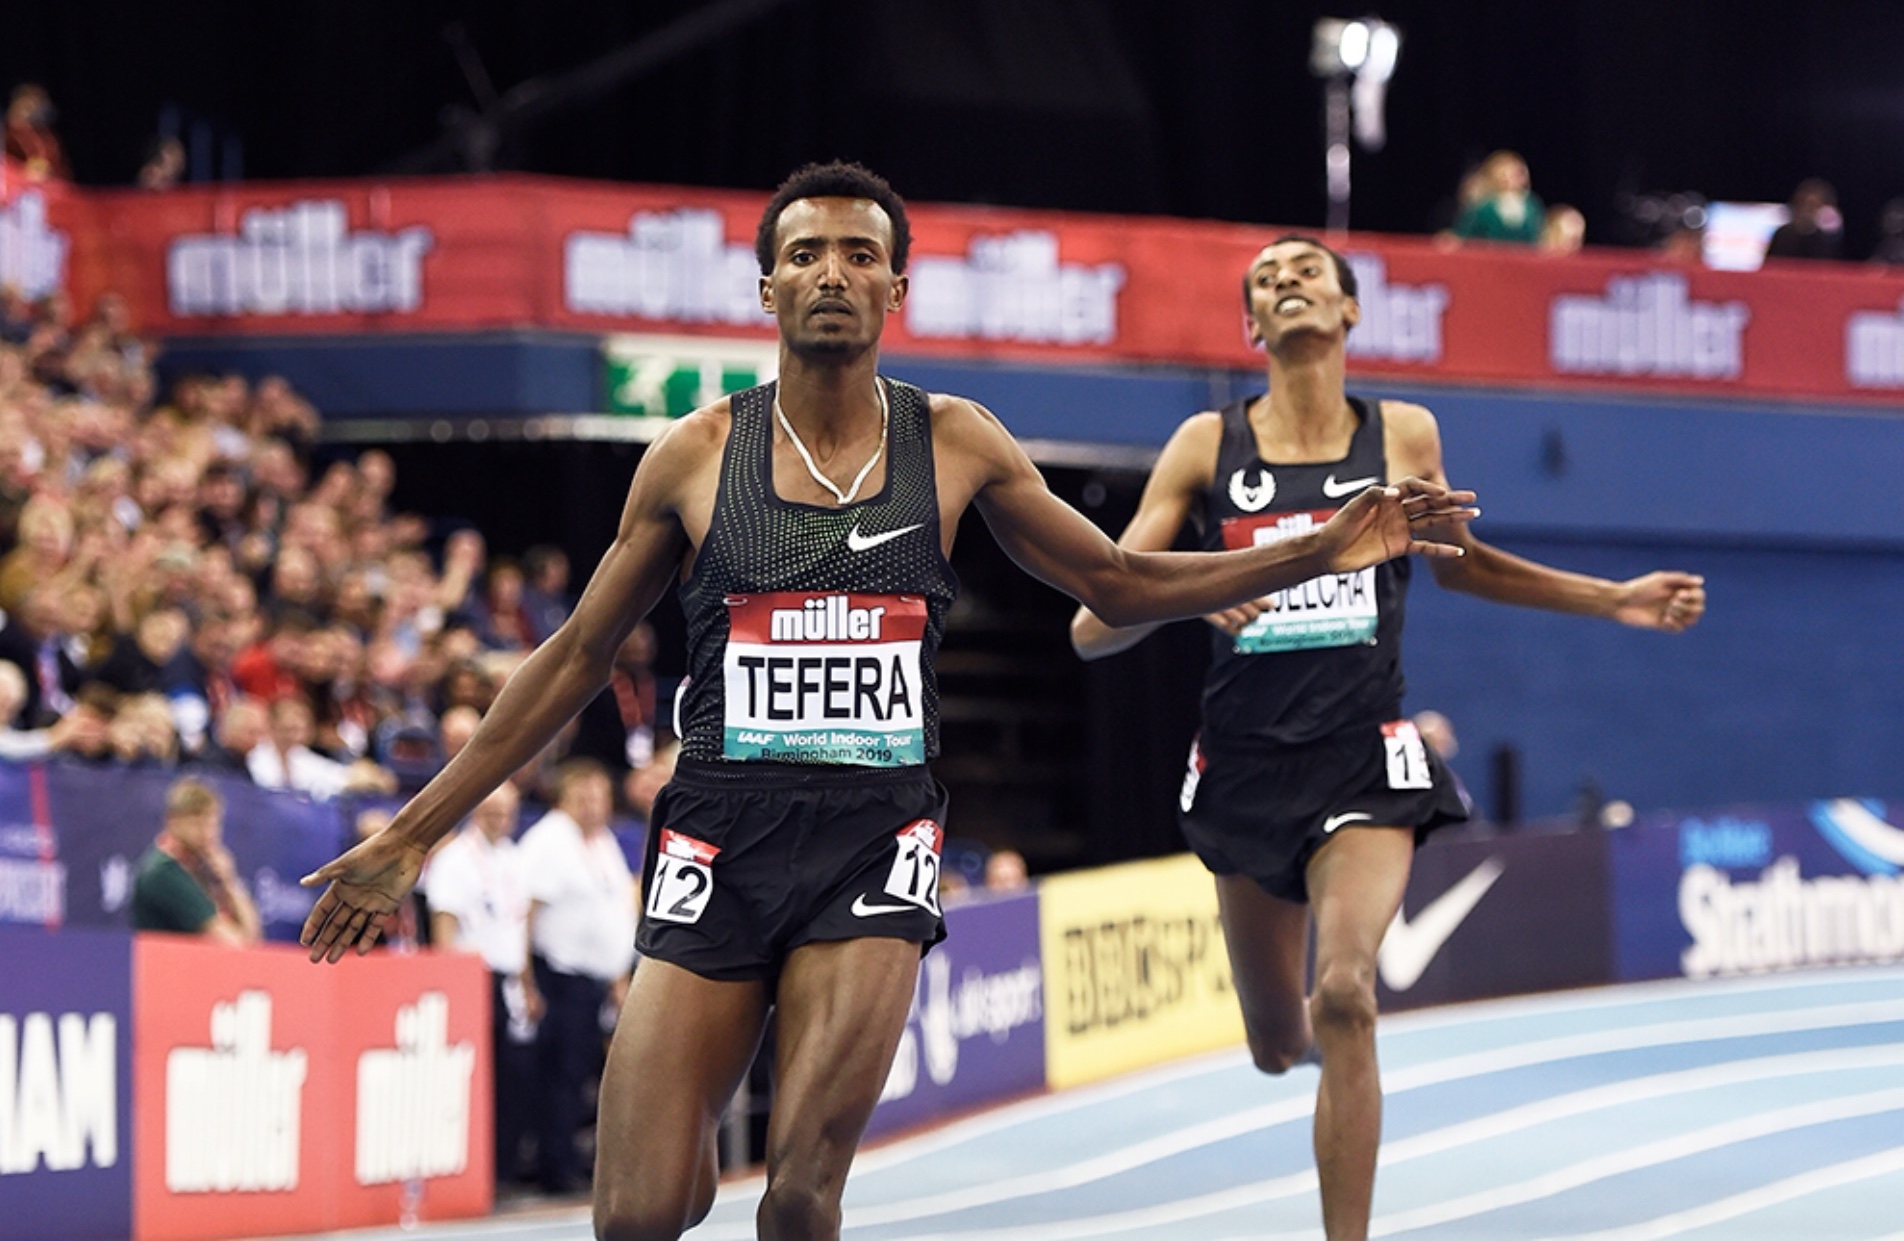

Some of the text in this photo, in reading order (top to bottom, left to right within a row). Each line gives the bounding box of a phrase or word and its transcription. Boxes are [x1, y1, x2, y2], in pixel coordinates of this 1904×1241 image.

[771, 595, 885, 641] müller
[738, 654, 912, 721] TEFERA
[737, 731, 912, 747] IAAF World Indoor Tour
[856, 748, 893, 762] 2019
[652, 860, 708, 918] 12
[905, 844, 937, 909] 12
